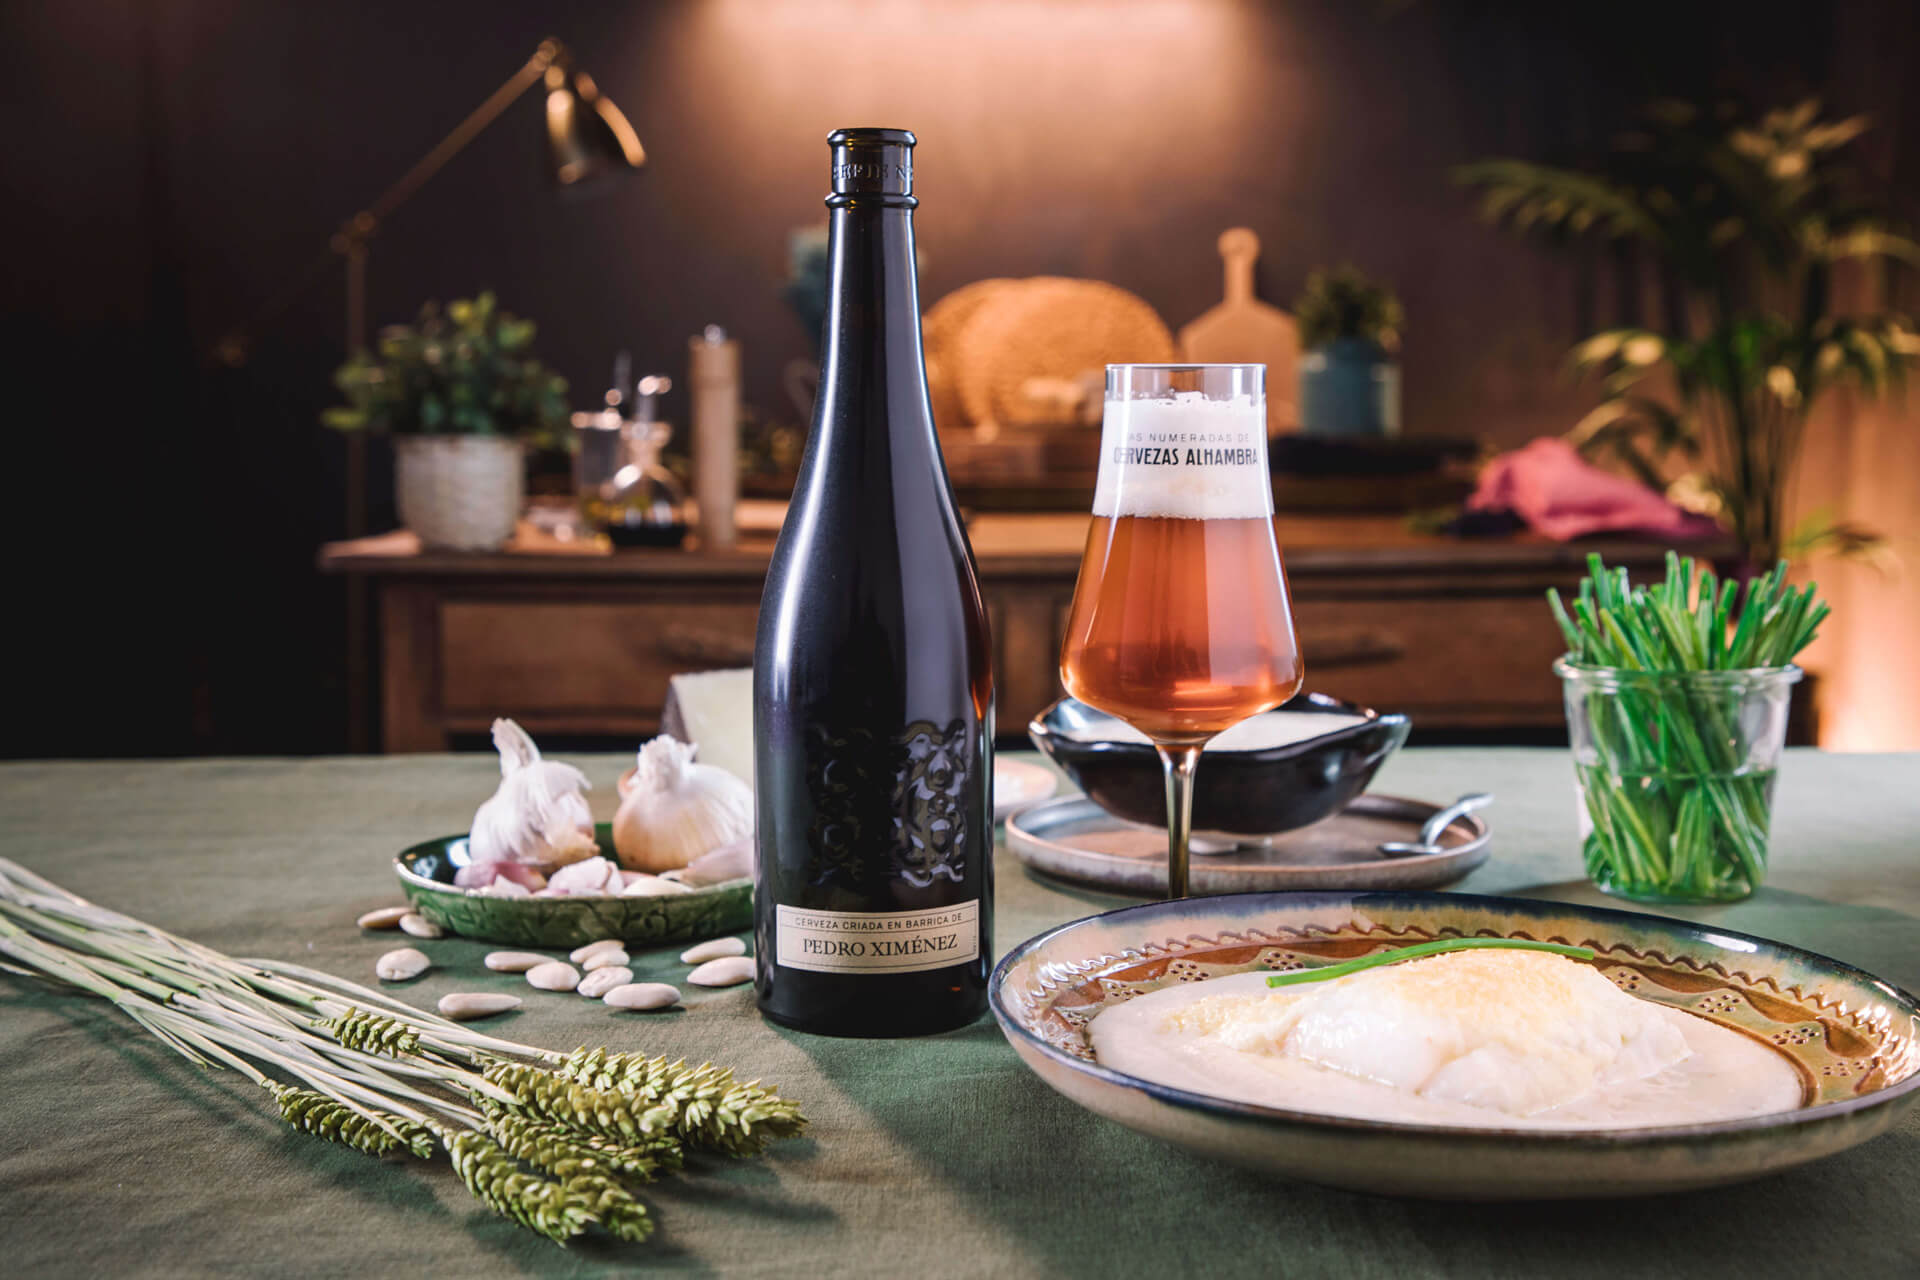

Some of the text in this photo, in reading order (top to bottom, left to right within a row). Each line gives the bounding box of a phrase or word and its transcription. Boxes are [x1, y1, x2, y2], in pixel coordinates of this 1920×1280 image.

[1126, 432, 1249, 443] AS NUMERADAS DE
[1113, 447, 1259, 466] CERVEZAS ALHAMBRA
[795, 912, 962, 931] CERVEZA CRIADA EN BARRICA DE
[802, 938, 865, 957] PEDRO
[869, 933, 958, 957] XIMÉNEZ
